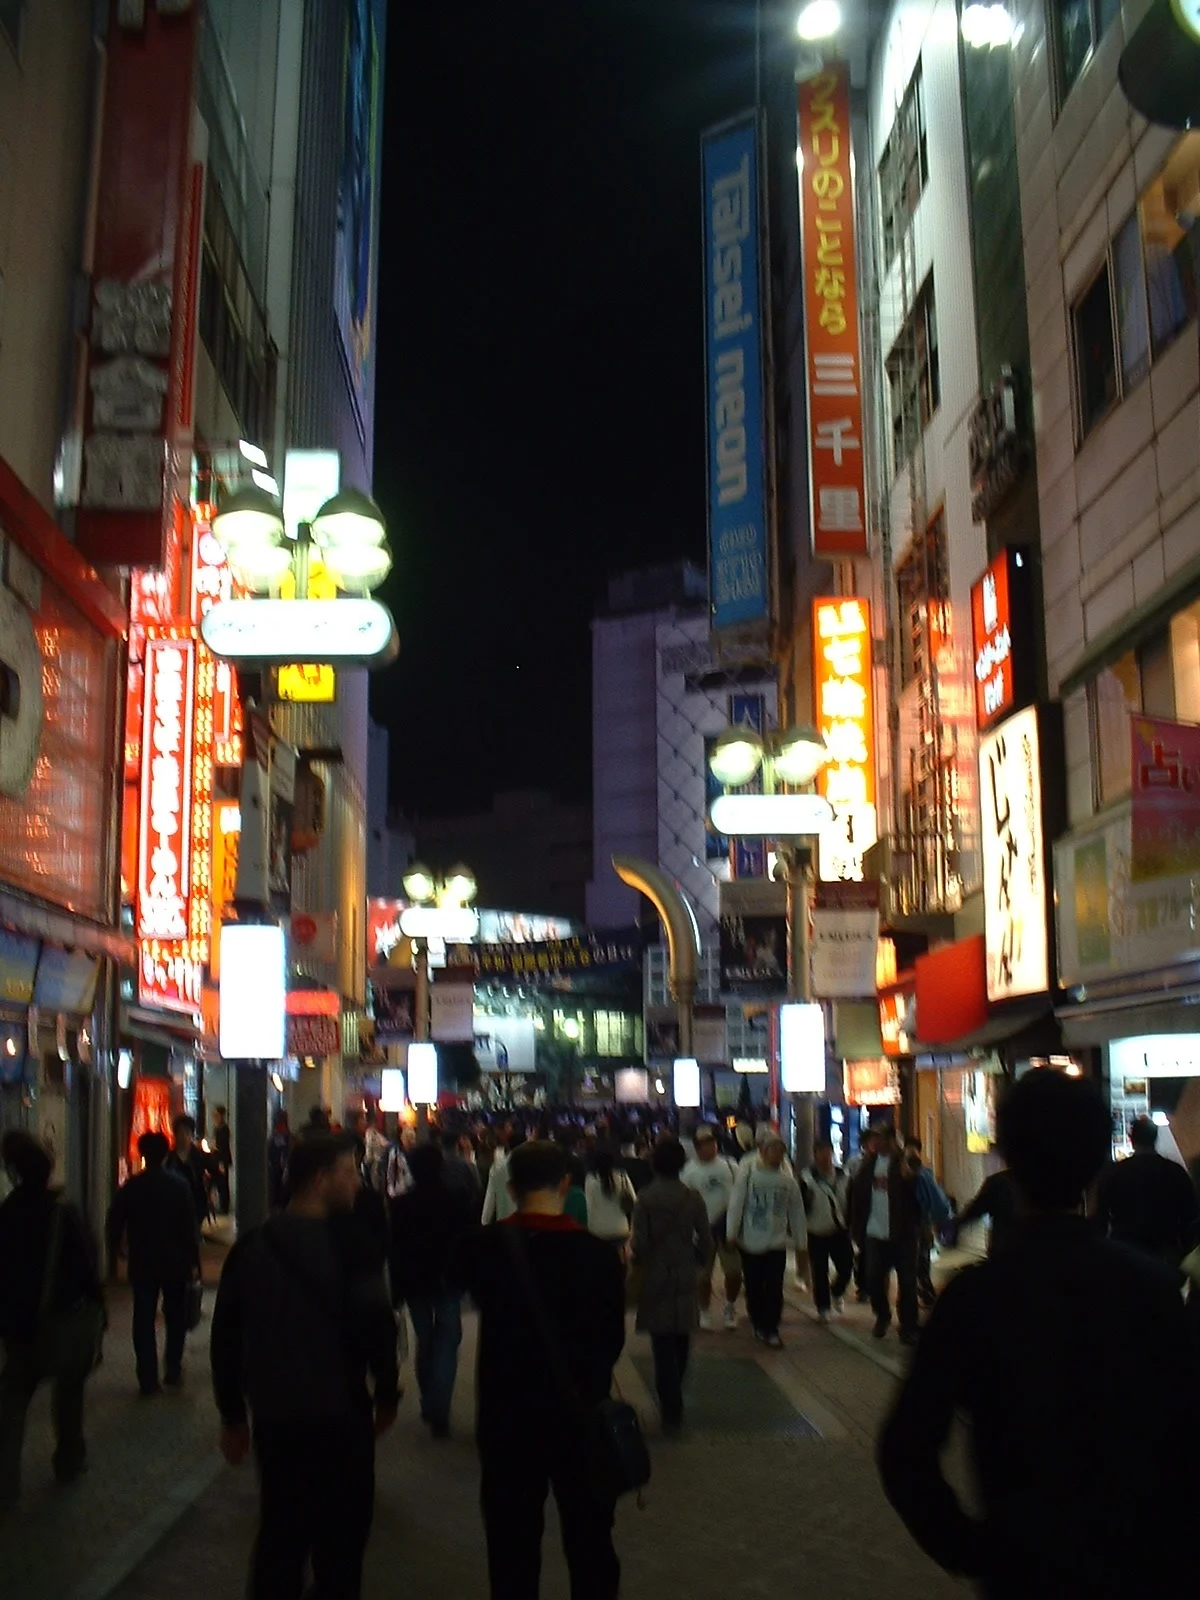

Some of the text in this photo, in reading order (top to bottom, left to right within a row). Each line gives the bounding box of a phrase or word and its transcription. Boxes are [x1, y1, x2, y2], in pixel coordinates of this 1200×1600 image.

[712, 154, 752, 341] Taisei
[809, 74, 863, 532] クスリのことなら 三千里
[715, 348, 748, 506] neon
